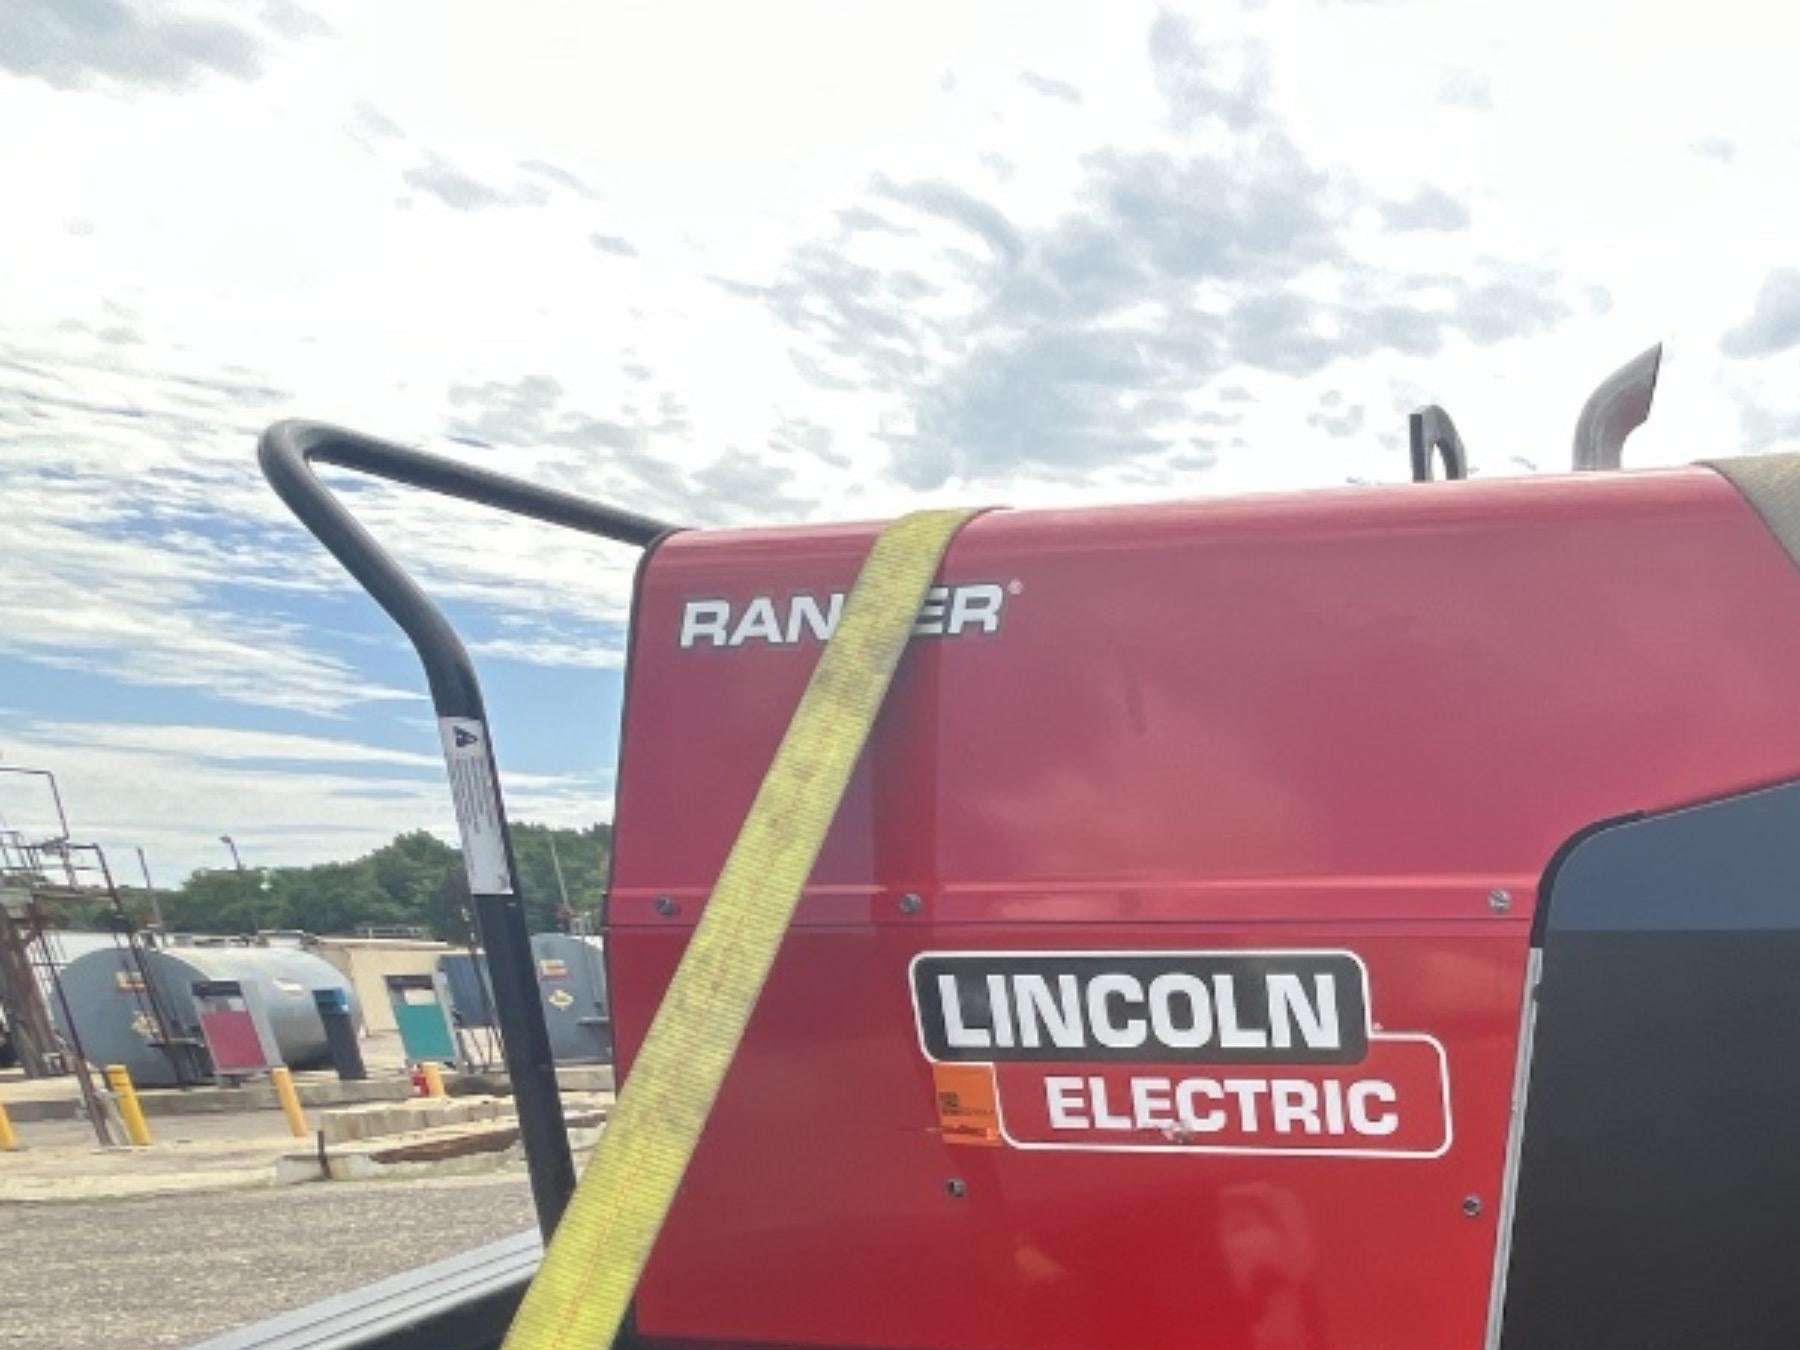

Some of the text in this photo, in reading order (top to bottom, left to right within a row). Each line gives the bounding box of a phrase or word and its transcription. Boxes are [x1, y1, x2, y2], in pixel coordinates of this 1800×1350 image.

[680, 584, 1003, 647] RANER
[937, 974, 1341, 1048] LINCOLN
[1044, 1076, 1399, 1135] ELECTRIC
